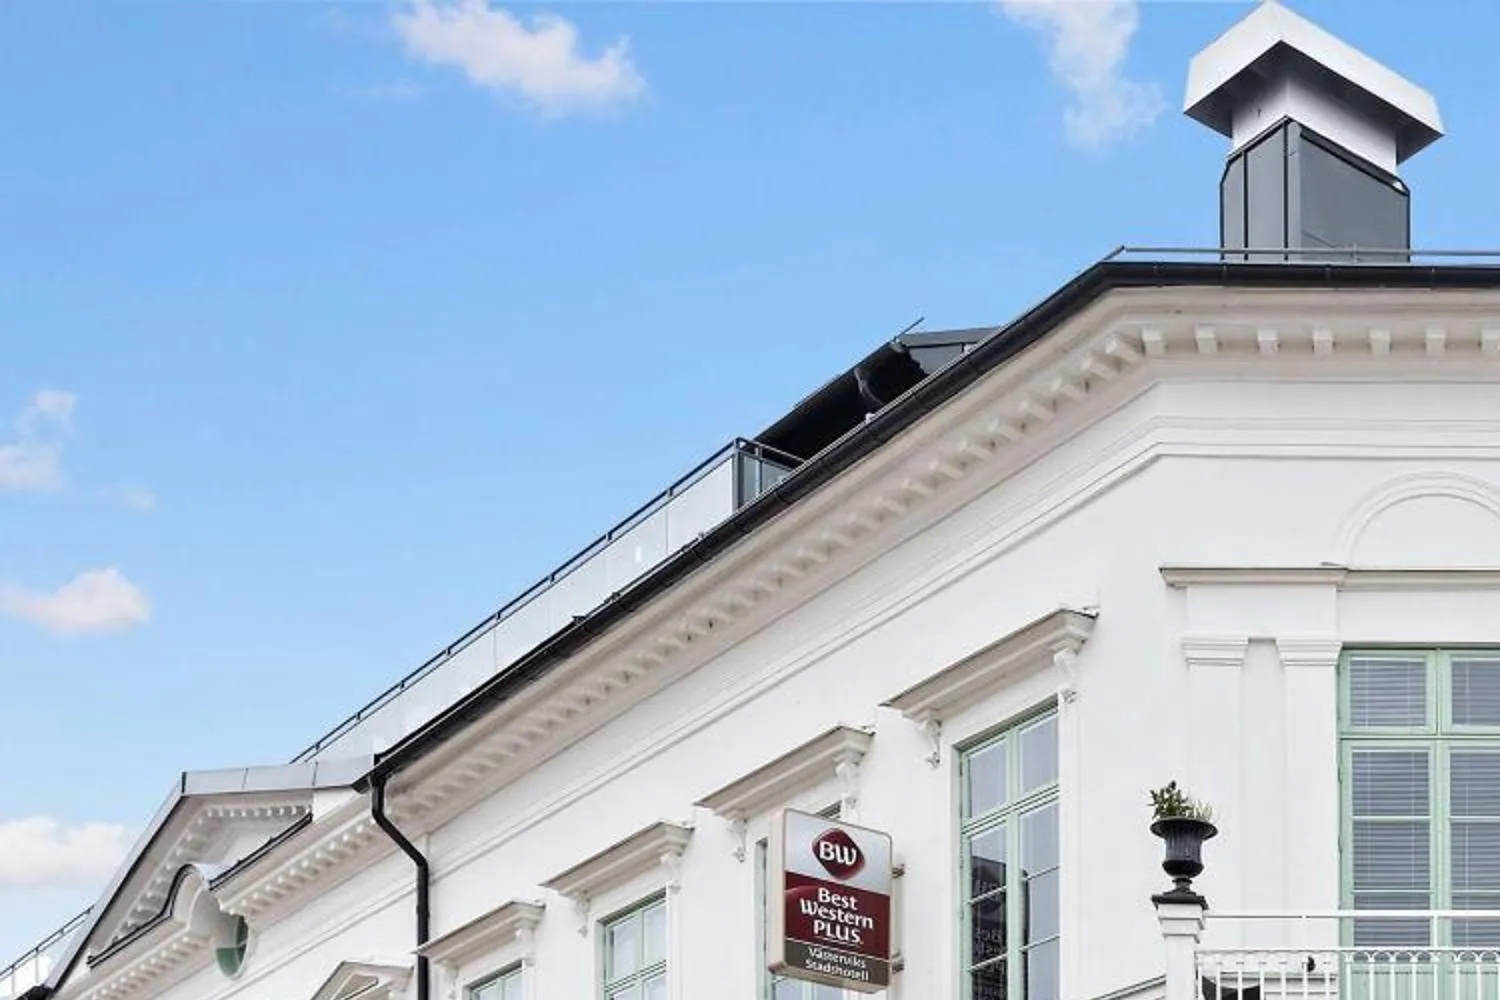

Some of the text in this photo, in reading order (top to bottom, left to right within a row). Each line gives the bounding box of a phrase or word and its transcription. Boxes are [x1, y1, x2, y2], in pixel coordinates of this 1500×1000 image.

[819, 841, 857, 866] BW
[818, 887, 858, 911] Best
[800, 898, 873, 930] Western
[814, 919, 861, 943] PLUS
